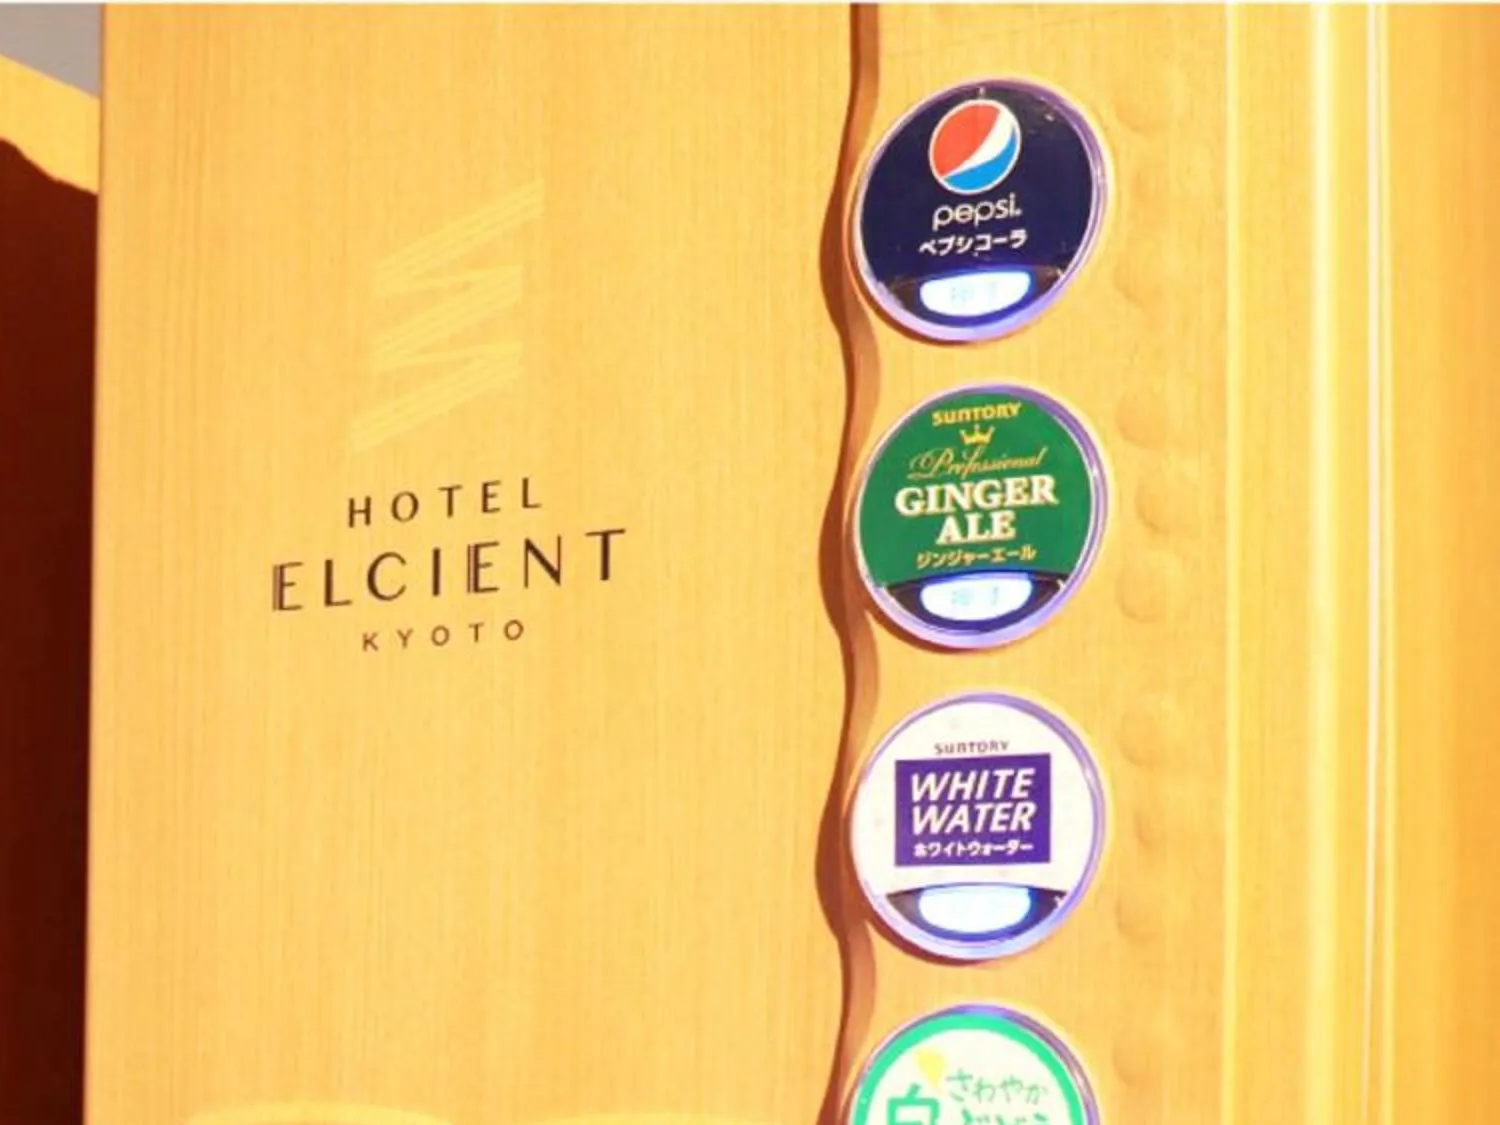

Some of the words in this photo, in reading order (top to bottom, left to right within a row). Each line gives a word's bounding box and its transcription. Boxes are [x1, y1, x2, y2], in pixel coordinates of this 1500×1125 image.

[918, 229, 1028, 257] ペプシコーラ
[906, 445, 1049, 481] Professional
[347, 476, 542, 528] HOTEL
[894, 474, 1060, 516] GINGER
[935, 509, 1018, 545] ALE
[272, 527, 626, 612] ELCIENT
[915, 543, 1037, 570] ジンジャーエール
[361, 618, 525, 653] KYOTO
[910, 767, 1036, 803] WHITE
[911, 801, 1037, 836] WATER
[913, 839, 1034, 858] ホワイトウォーター
[945, 1067, 1049, 1106] さわやか
